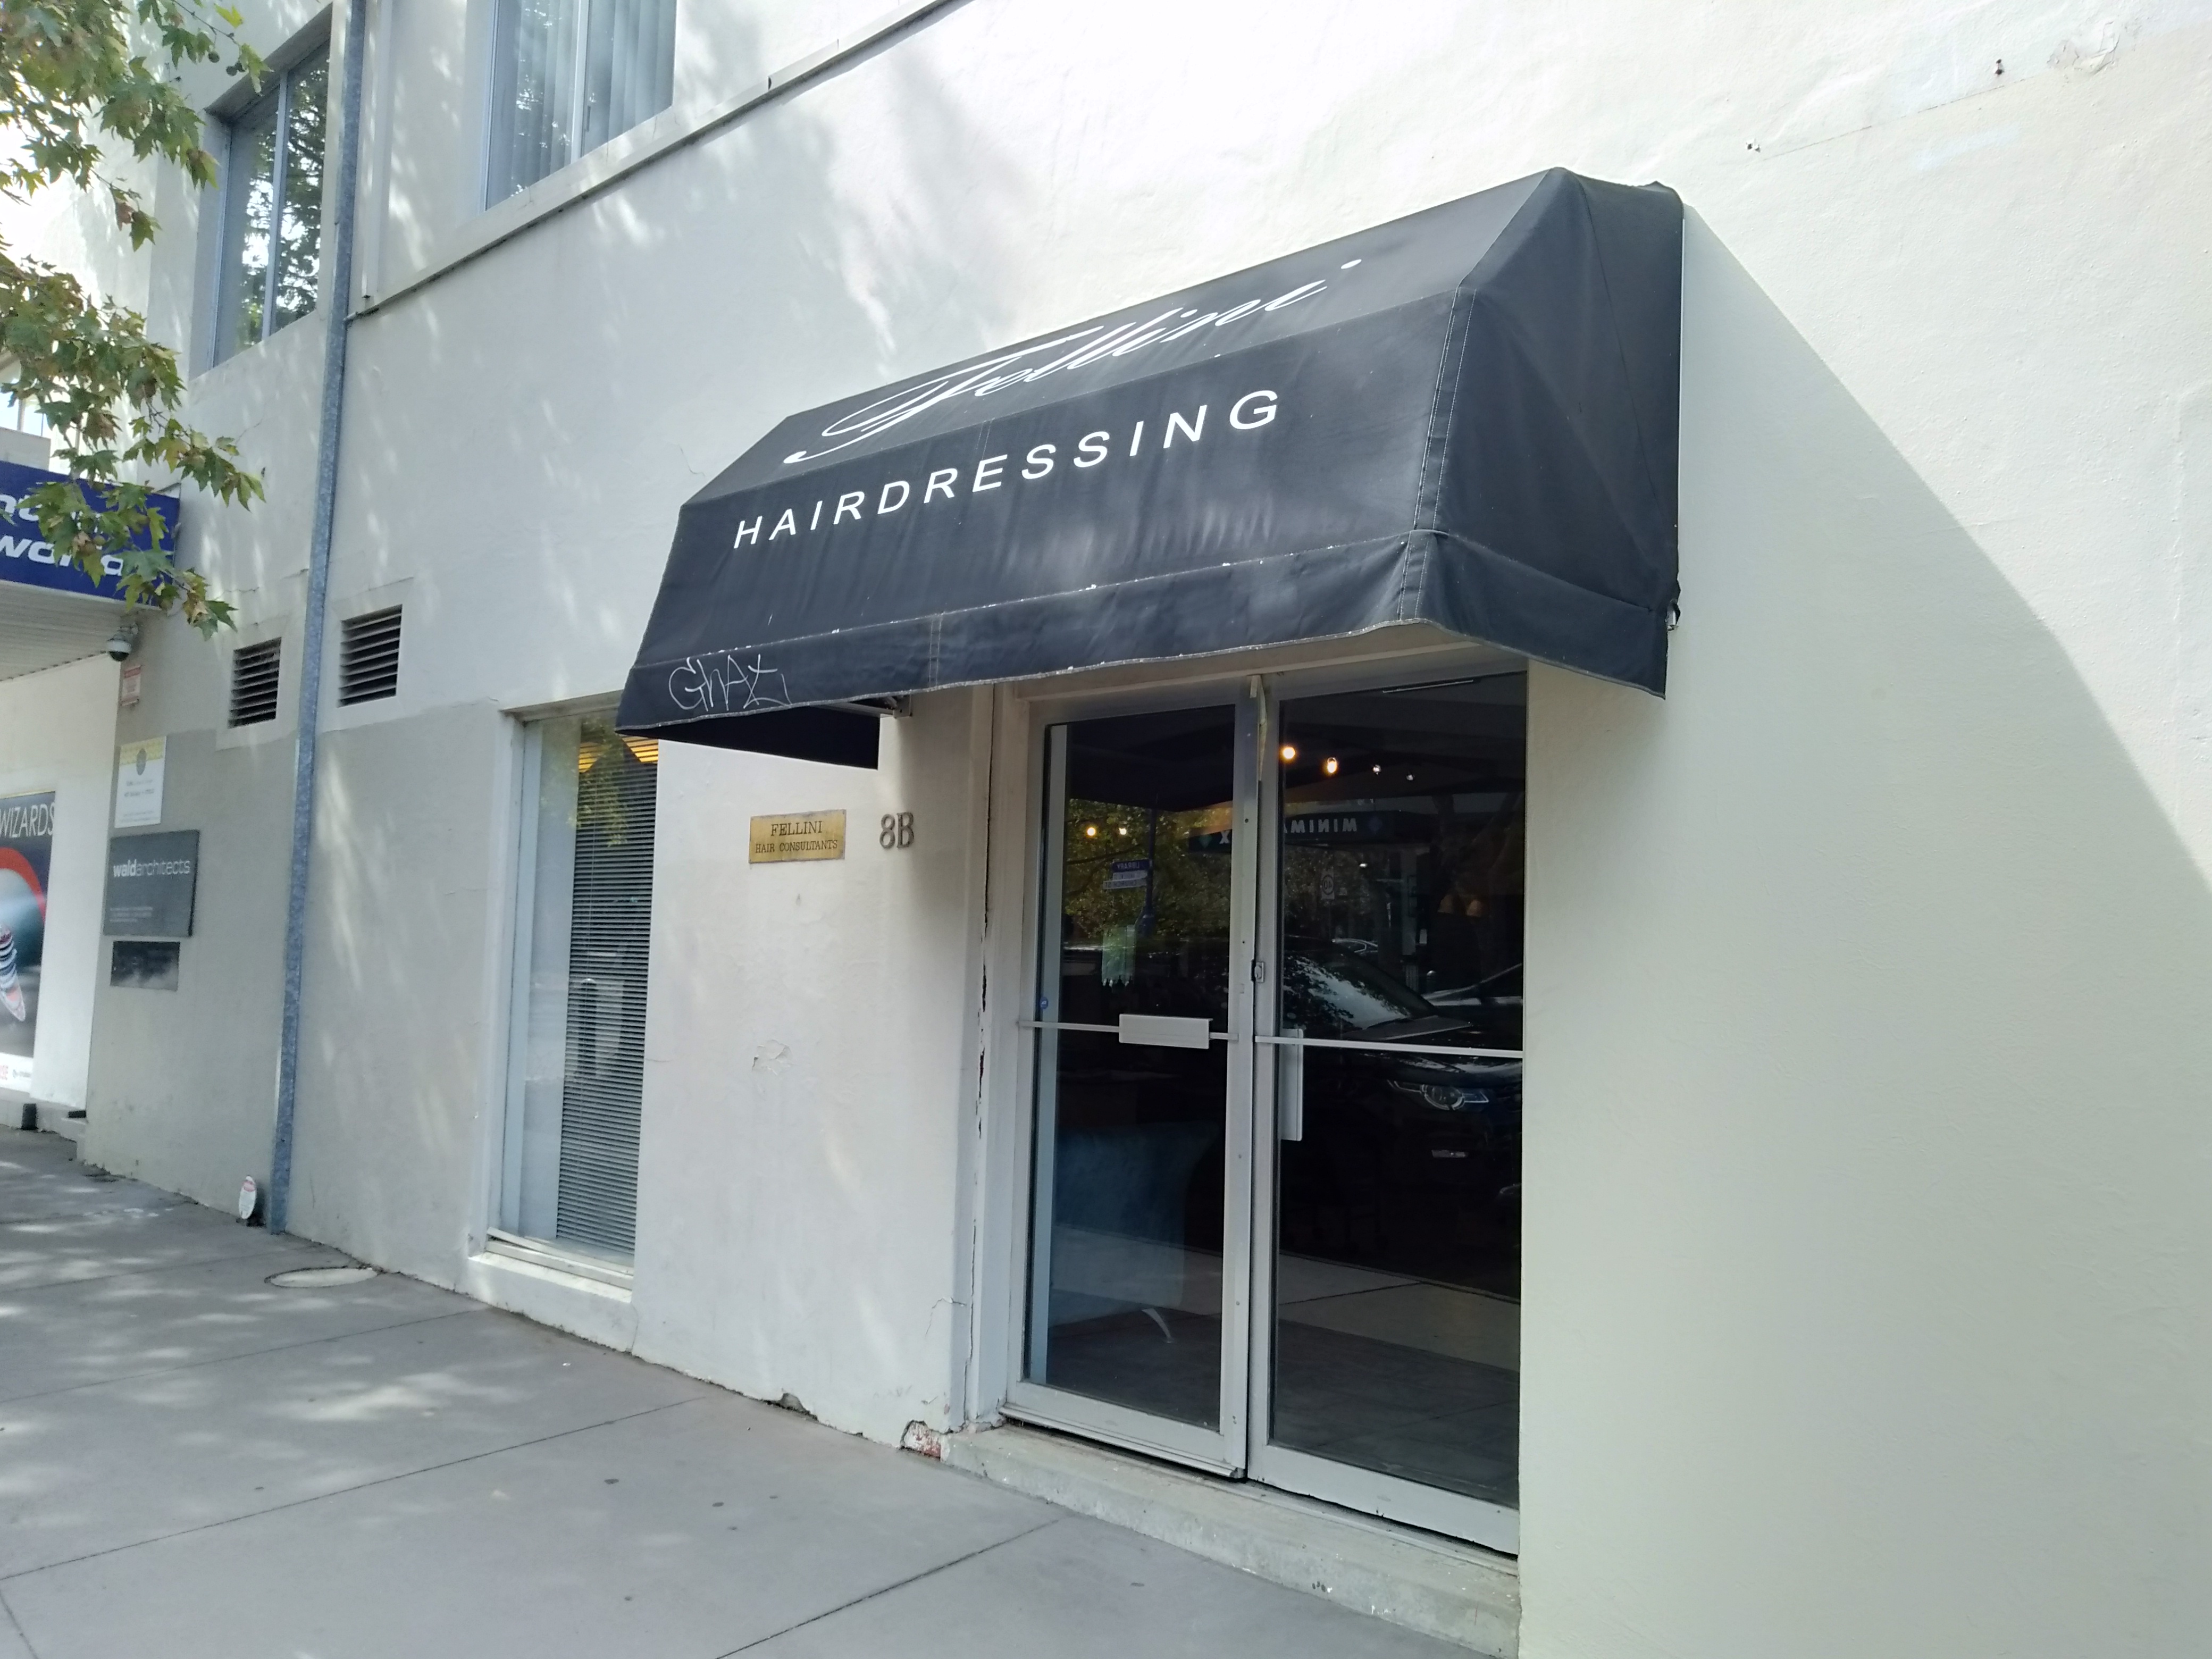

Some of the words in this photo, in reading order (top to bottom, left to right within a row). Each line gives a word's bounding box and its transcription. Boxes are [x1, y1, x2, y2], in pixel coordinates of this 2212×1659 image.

[784, 258, 1362, 464] Fellini
[733, 390, 1278, 549] HAIRDRESSING
[755, 843, 775, 853] HAIR
[779, 840, 838, 851] CONSULTANTS
[770, 820, 823, 836] FELLINI
[879, 811, 915, 849] 8B
